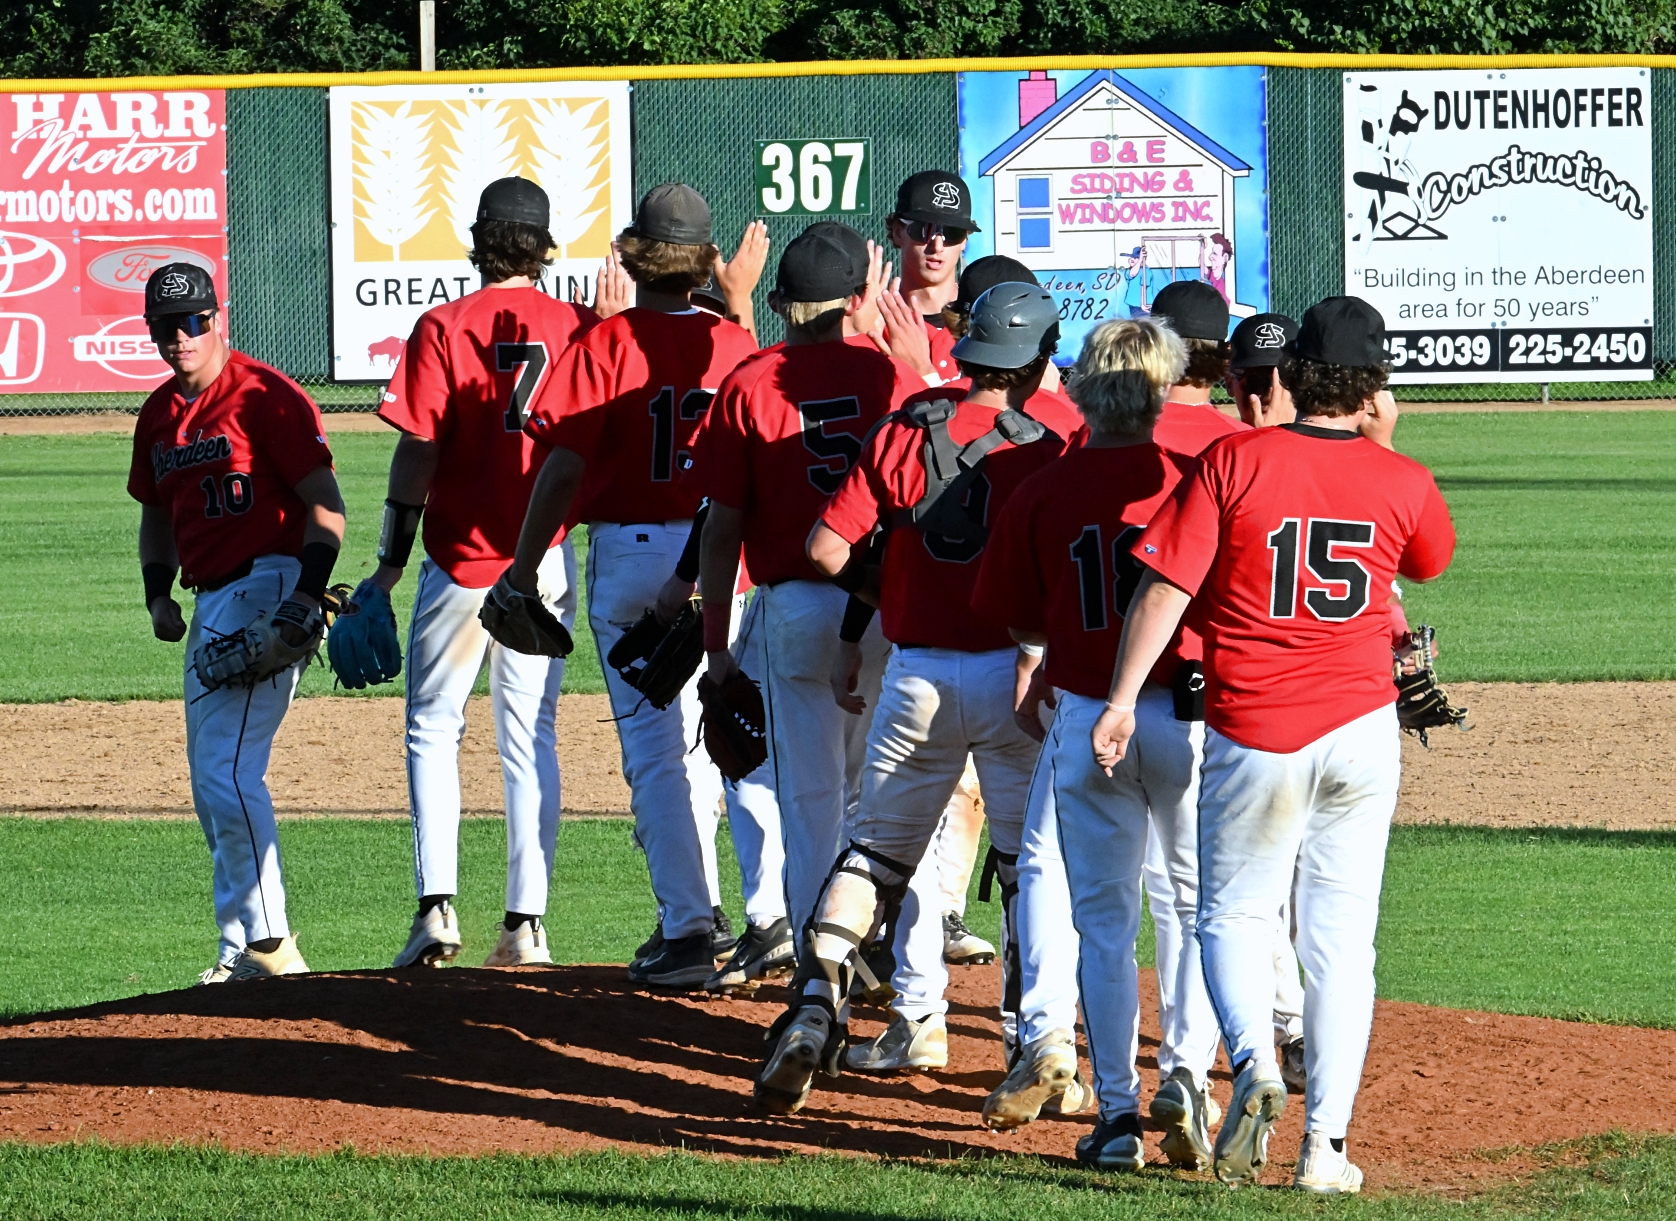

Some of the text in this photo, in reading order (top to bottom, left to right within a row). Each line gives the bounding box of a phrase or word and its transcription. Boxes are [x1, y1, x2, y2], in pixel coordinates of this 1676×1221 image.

[11, 92, 216, 139] HARR
[1434, 87, 1644, 130] DUTENHOFFER
[11, 117, 207, 179] Motors
[1091, 140, 1166, 163] B & E
[762, 141, 864, 213] 367
[1070, 169, 1194, 194] SIDING &
[1420, 145, 1645, 221] Construction
[1057, 200, 1213, 224] WINDOWS INC.
[114, 252, 171, 283] Fo
[1092, 272, 1121, 291] SD
[1465, 267, 1483, 286] in
[1492, 266, 1527, 286] the
[1534, 265, 1645, 286] Aberdeen
[355, 276, 470, 306] GREAT
[1398, 302, 1448, 318] area
[1456, 298, 1486, 318] for
[1493, 298, 1521, 317] 50
[1059, 297, 1109, 321] 8782
[86, 341, 158, 355] NISS
[1383, 332, 1646, 366] 5-3039 225-2450
[495, 341, 550, 433] 7
[152, 429, 232, 484] Aberdeen
[798, 395, 862, 496] 5
[201, 472, 254, 519] 10
[1267, 517, 1376, 623] 15
